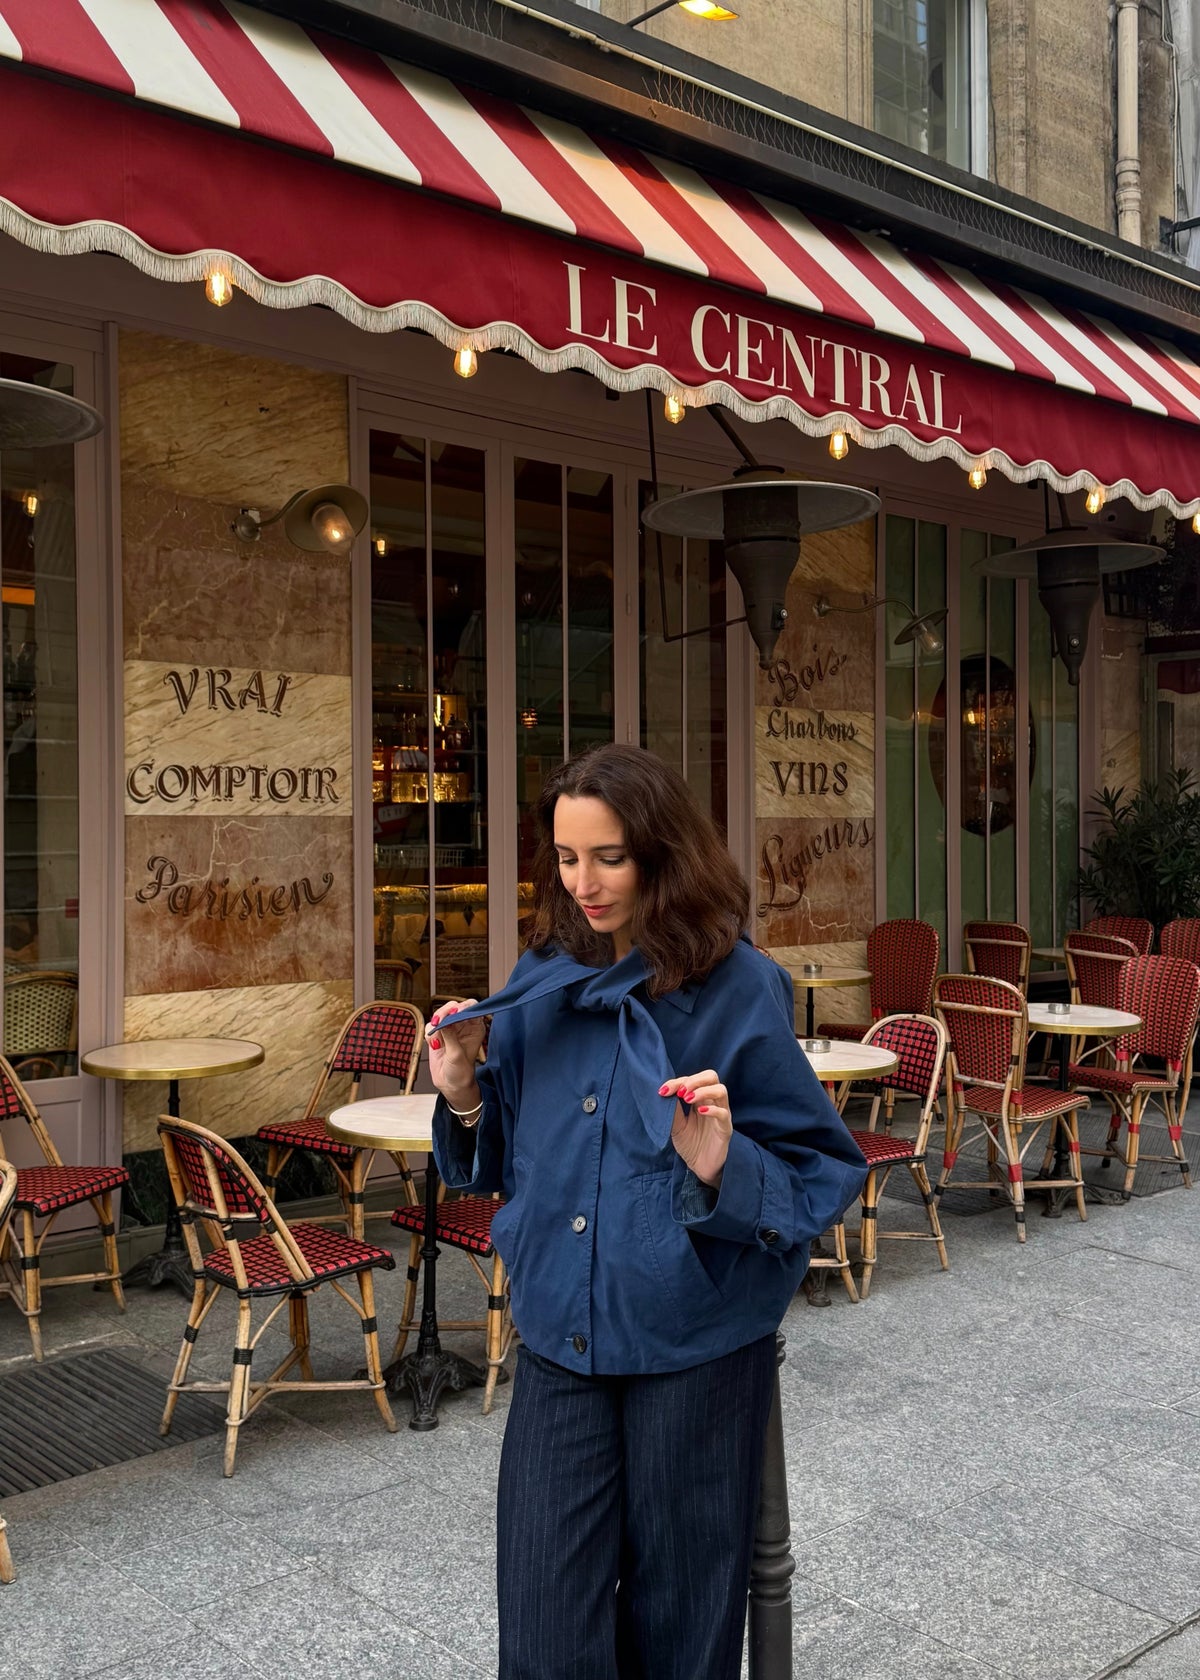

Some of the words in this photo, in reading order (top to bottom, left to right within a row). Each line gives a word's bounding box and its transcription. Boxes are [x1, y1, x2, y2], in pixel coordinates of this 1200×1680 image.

[562, 261, 658, 356] LE
[690, 304, 962, 433] CENTRAL
[163, 668, 292, 717] VRAI
[768, 643, 847, 707] Bois
[765, 708, 859, 741] Charbons
[127, 758, 340, 804] COMPTOIR
[135, 855, 334, 921] Parisien
